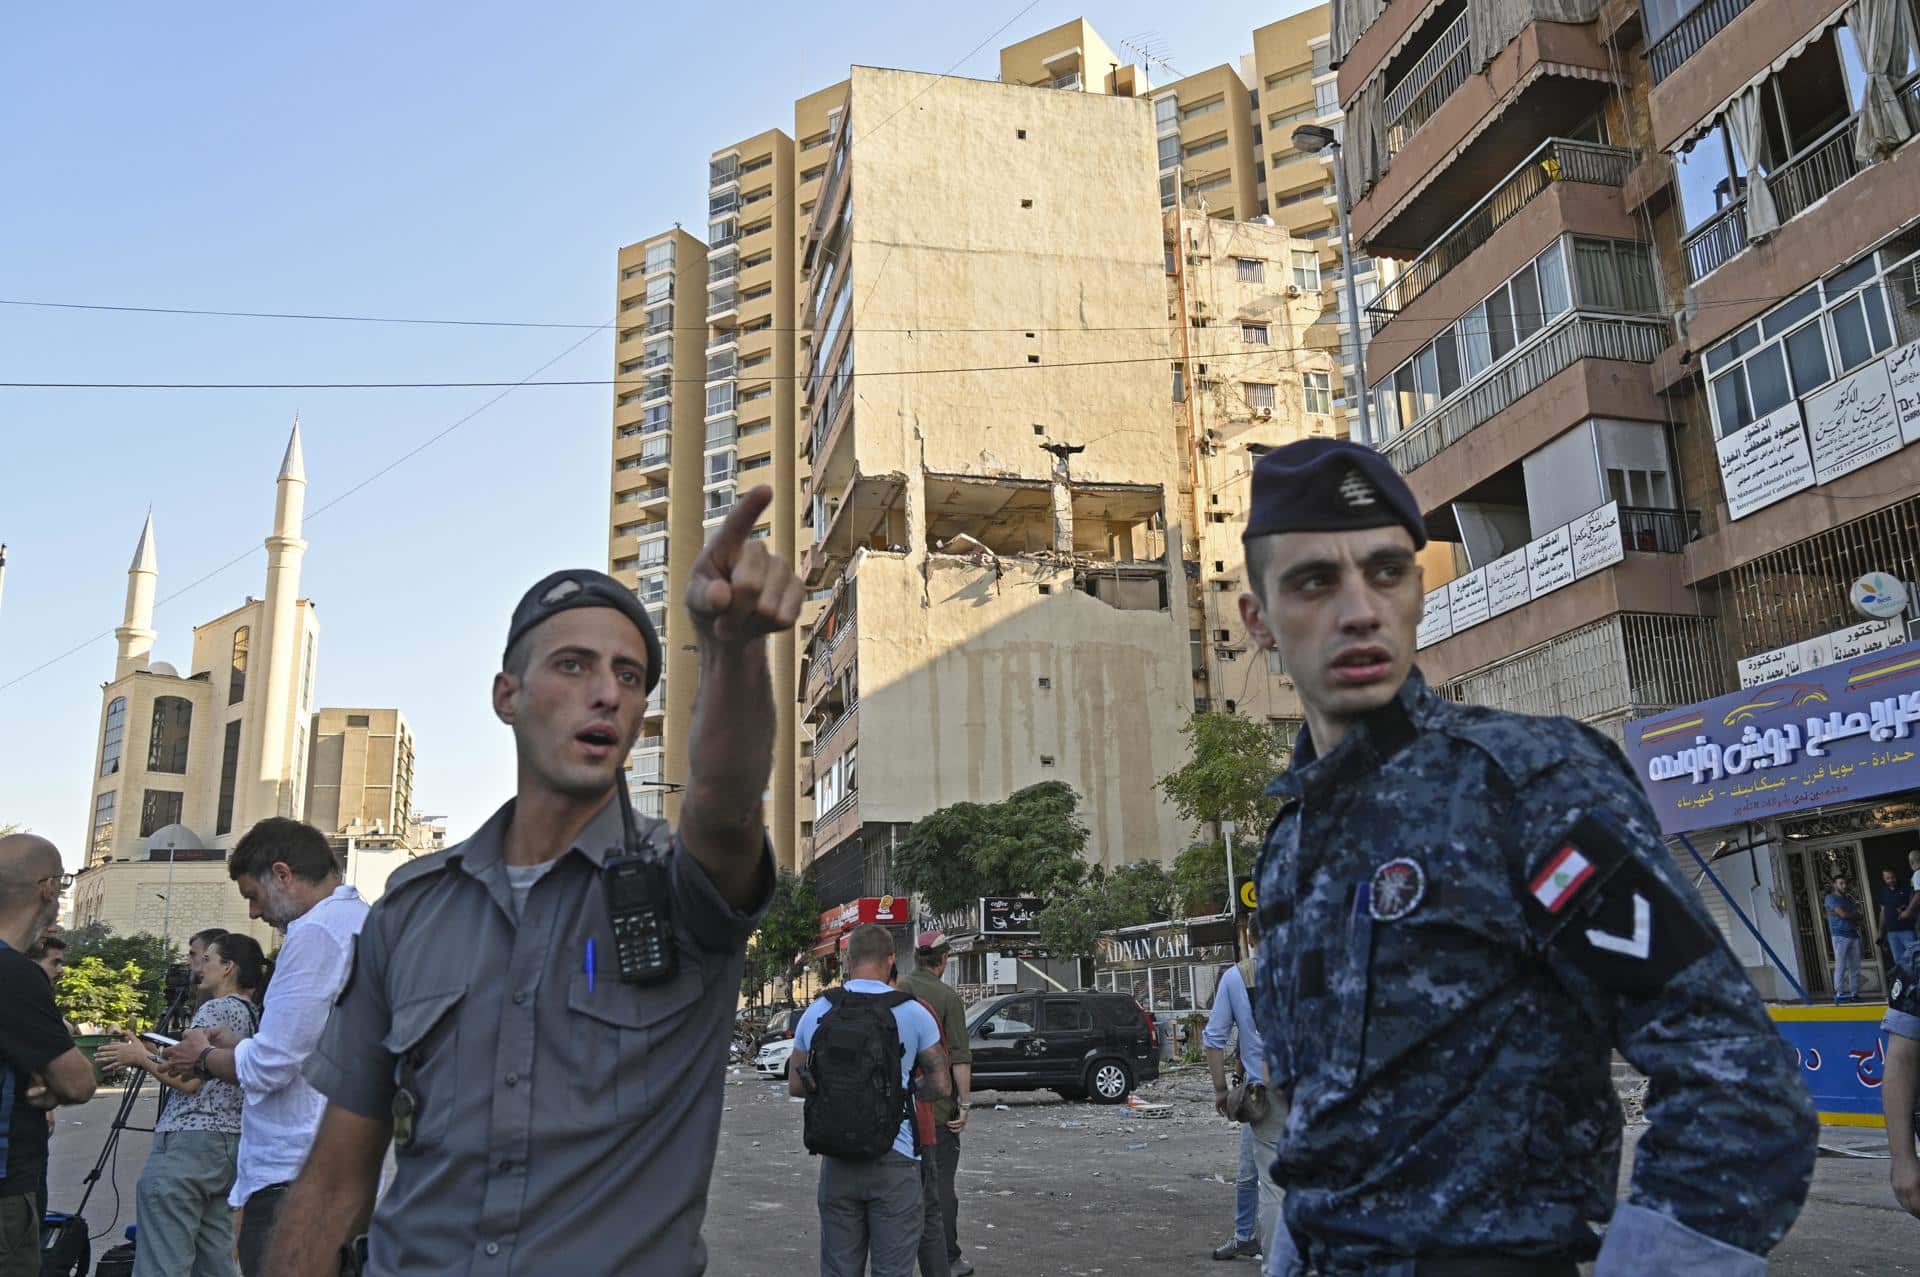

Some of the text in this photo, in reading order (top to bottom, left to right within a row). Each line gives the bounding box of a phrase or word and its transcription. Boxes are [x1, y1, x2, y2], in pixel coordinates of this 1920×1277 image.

[1898, 398, 1914, 412] Dr
[1744, 417, 1771, 443] الدكتور
[1774, 420, 1800, 439] محمود
[1743, 435, 1772, 457] مصطفى
[1845, 620, 1891, 643] الدكتور
[1748, 651, 1786, 671] الدكتورة
[1871, 751, 1915, 767] حدادة
[1730, 776, 1786, 799] ميكانيك
[1105, 938, 1151, 963] ADNAN
